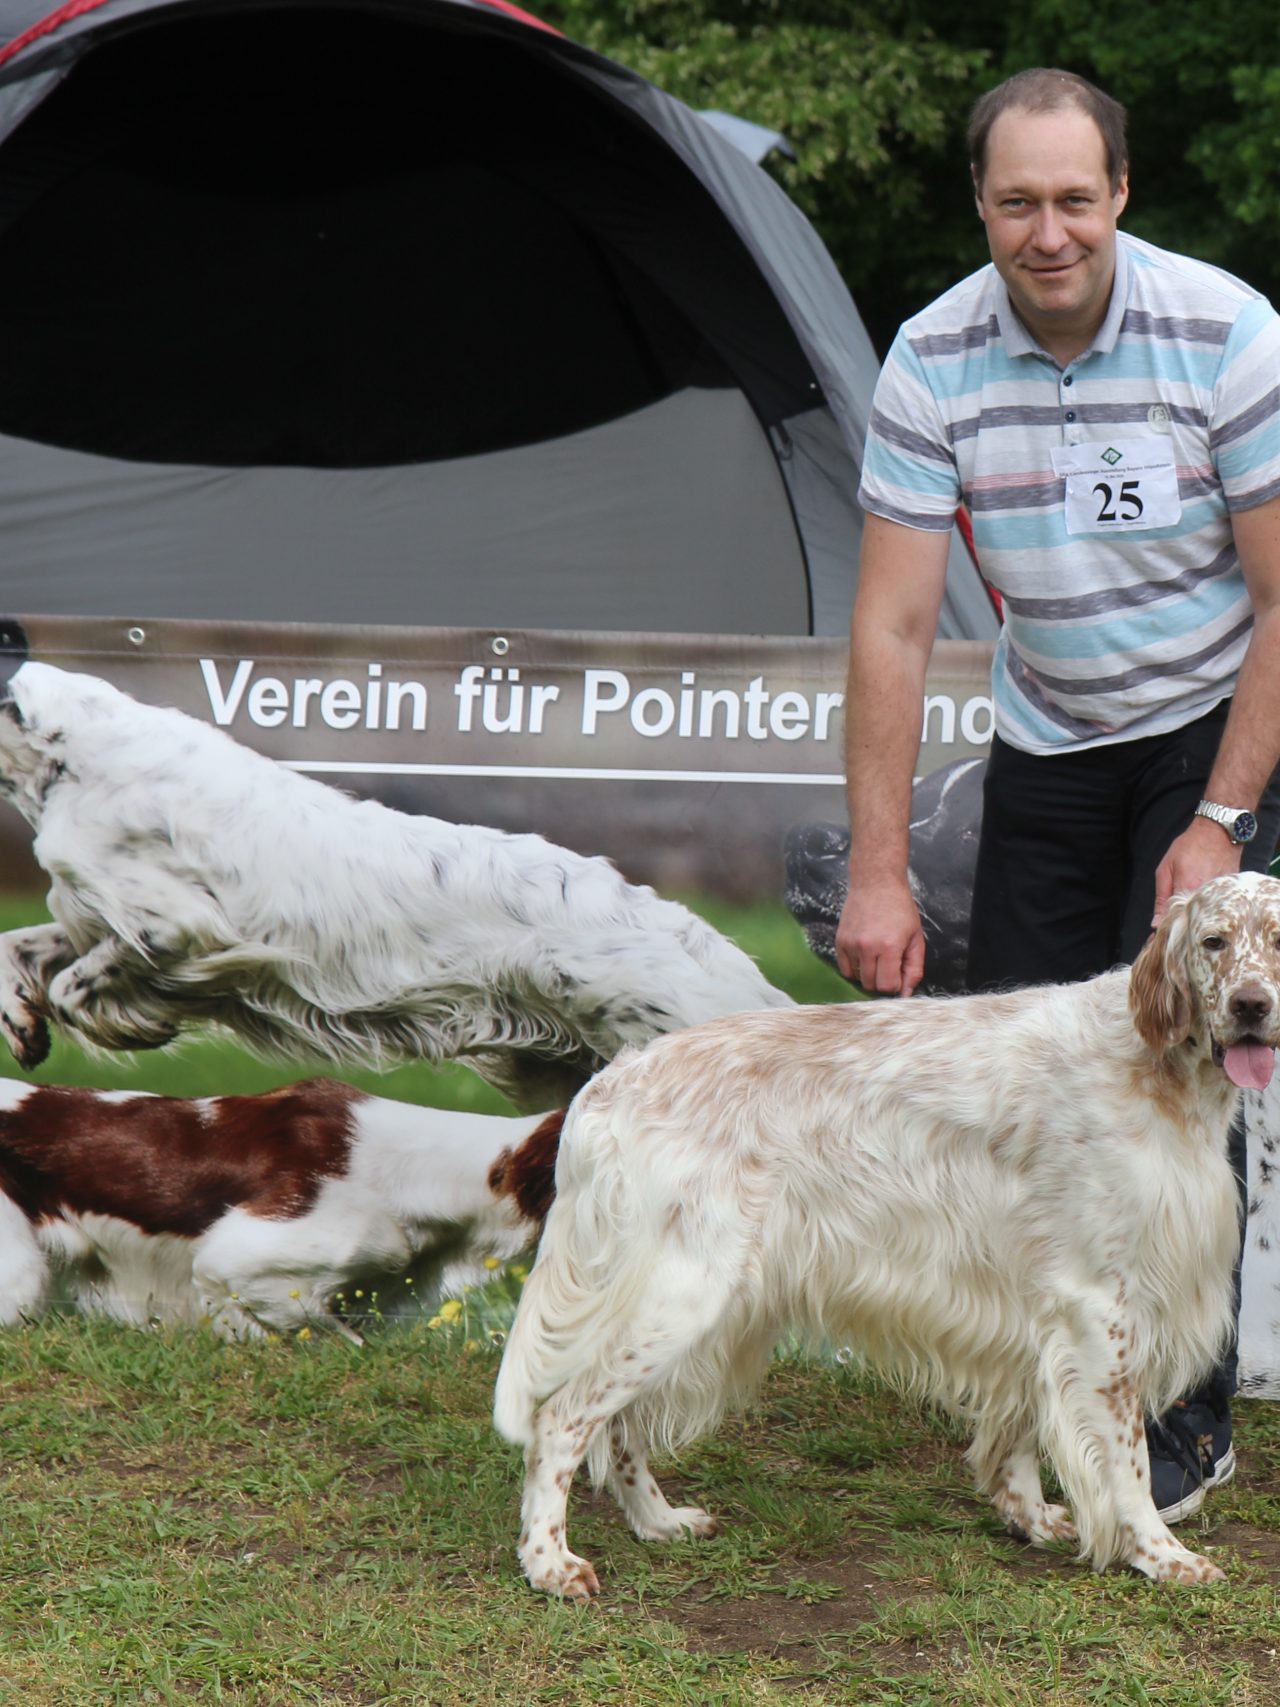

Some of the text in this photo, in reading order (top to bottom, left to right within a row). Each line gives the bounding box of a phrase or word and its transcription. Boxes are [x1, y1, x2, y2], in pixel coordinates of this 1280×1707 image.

[1092, 481, 1144, 521] 25
[199, 658, 428, 731] Verein
[454, 665, 560, 734] für
[581, 669, 845, 741] Pointer
